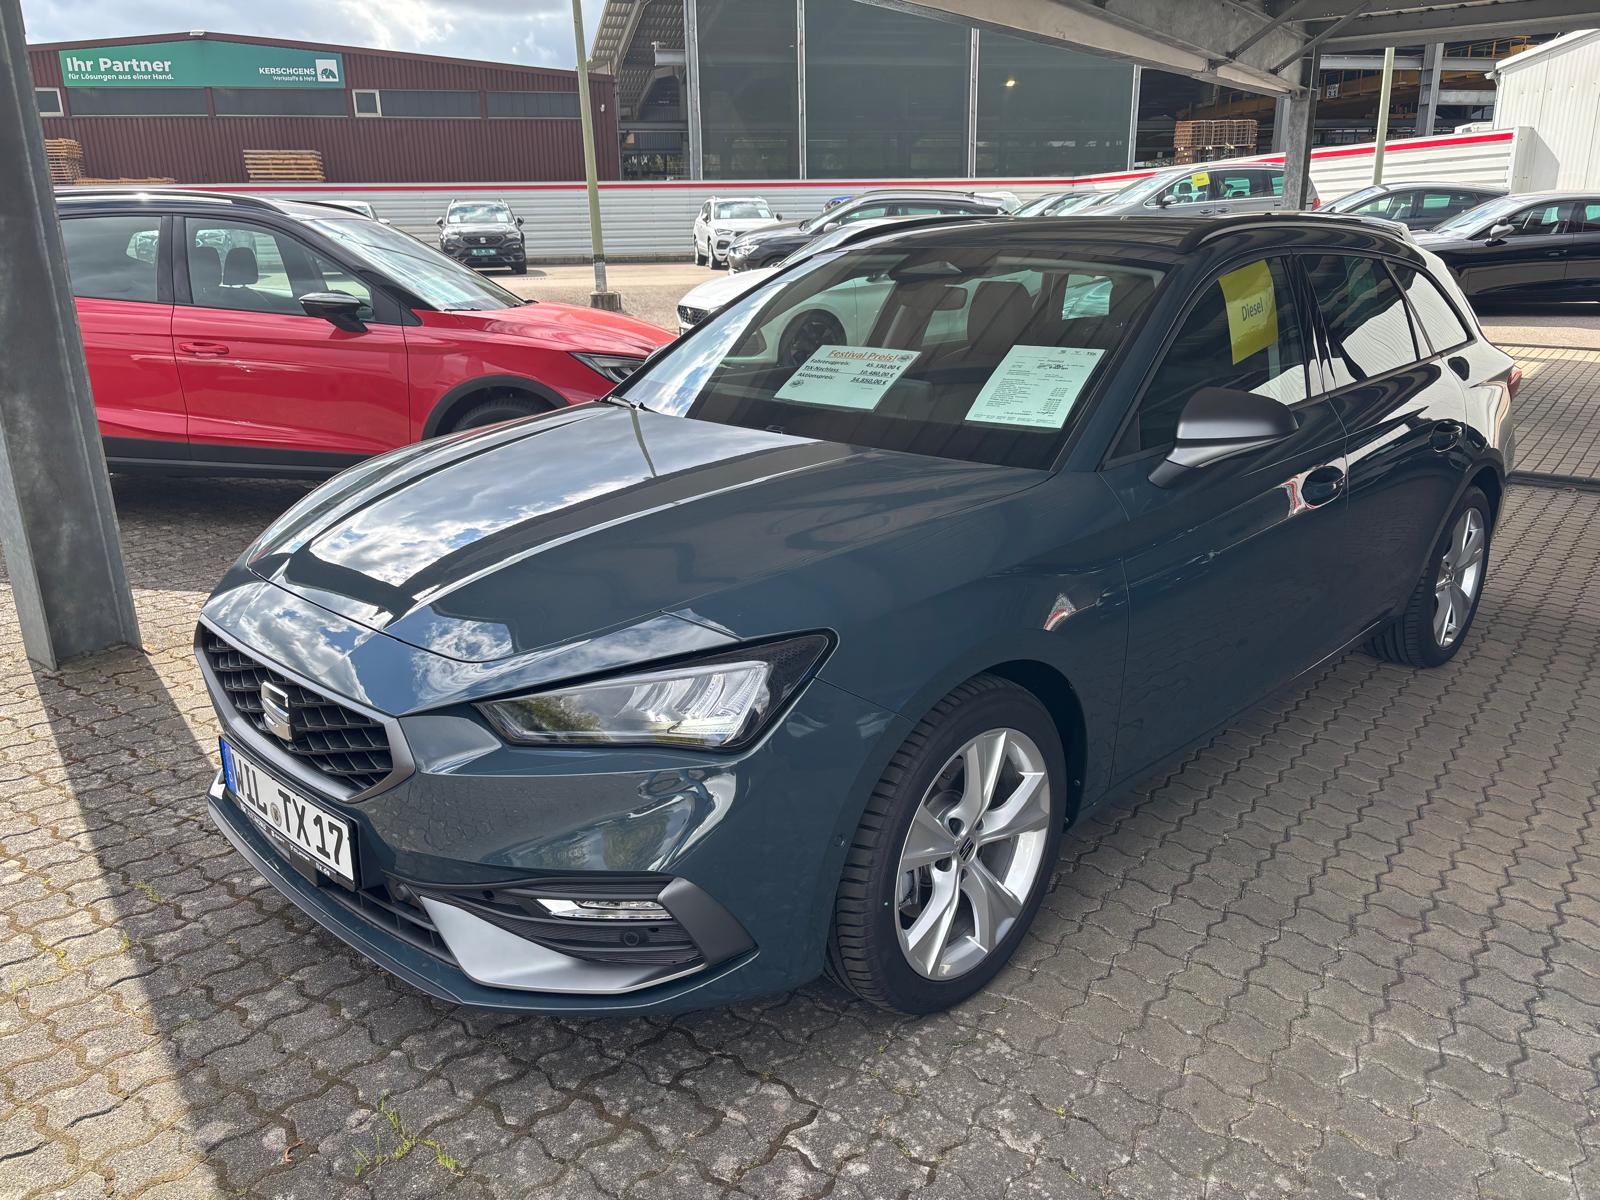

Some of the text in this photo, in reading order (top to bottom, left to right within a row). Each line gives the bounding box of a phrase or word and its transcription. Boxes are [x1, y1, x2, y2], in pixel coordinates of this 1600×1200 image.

[66, 57, 172, 72] Ihr Partner
[259, 67, 315, 75] KERSCHGENS
[1241, 297, 1264, 322] Diesel
[826, 350, 899, 361] Festival Preis!
[231, 753, 268, 816] WIL
